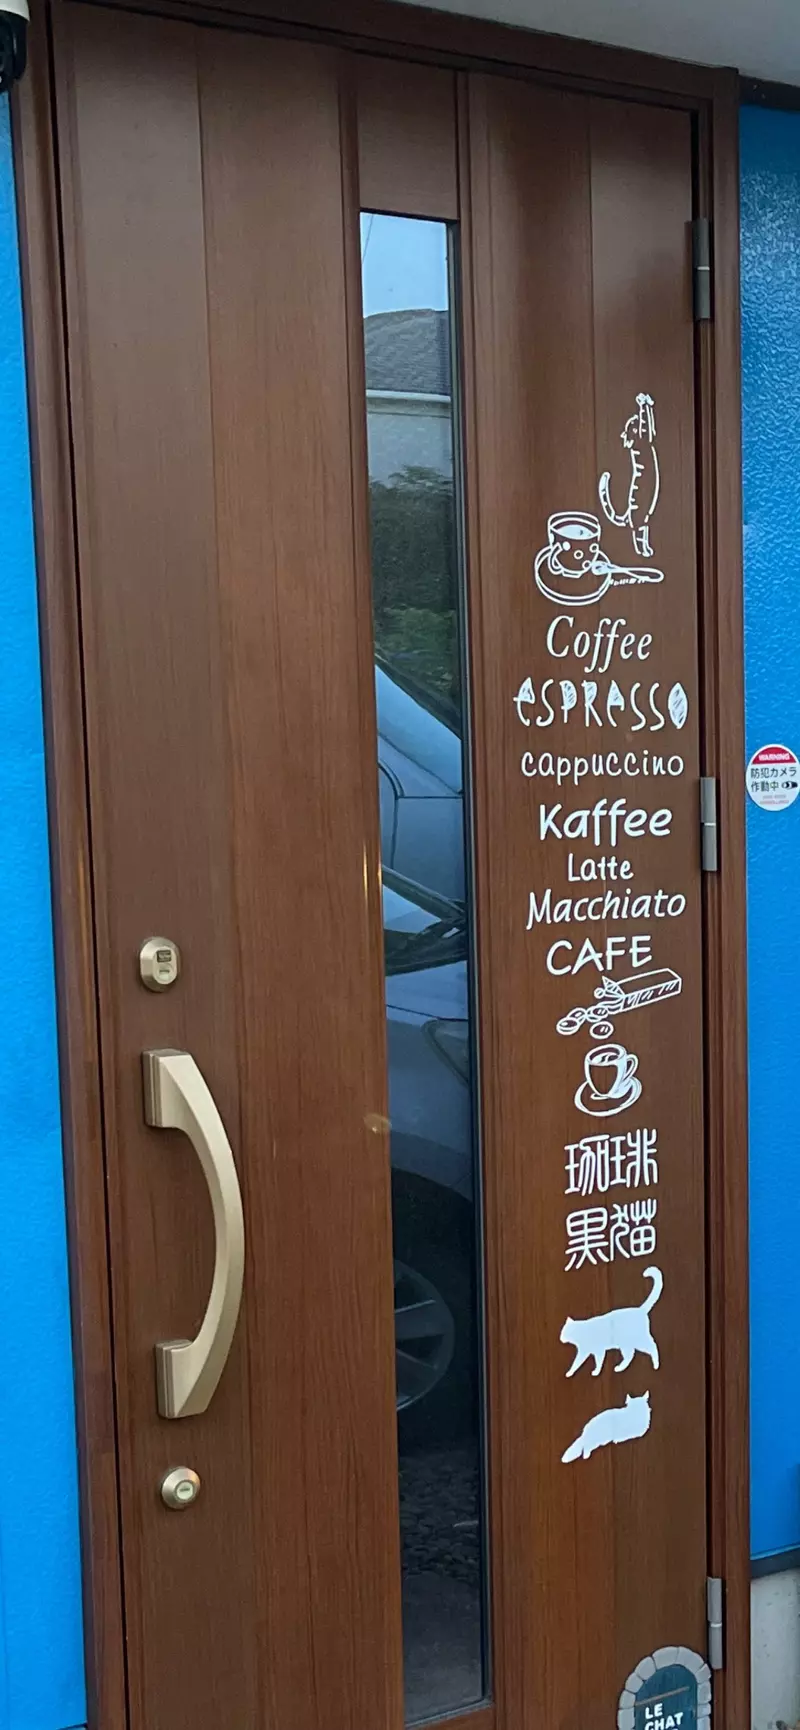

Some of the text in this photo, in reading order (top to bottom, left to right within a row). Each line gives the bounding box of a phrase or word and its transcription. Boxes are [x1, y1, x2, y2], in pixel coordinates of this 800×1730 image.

[546, 615, 653, 673] Coffee
[521, 750, 684, 786] cappuccino
[750, 766, 797, 779] 防犯カメラ
[750, 781, 779, 792] 作動中
[539, 798, 673, 847] Kaffee
[567, 853, 634, 882] Latte
[526, 888, 686, 930] Macchiato
[546, 935, 653, 976] CAFE
[564, 1128, 658, 1196] 珈琲
[564, 1198, 657, 1271] 黒猫
[645, 1703, 663, 1719] LE
